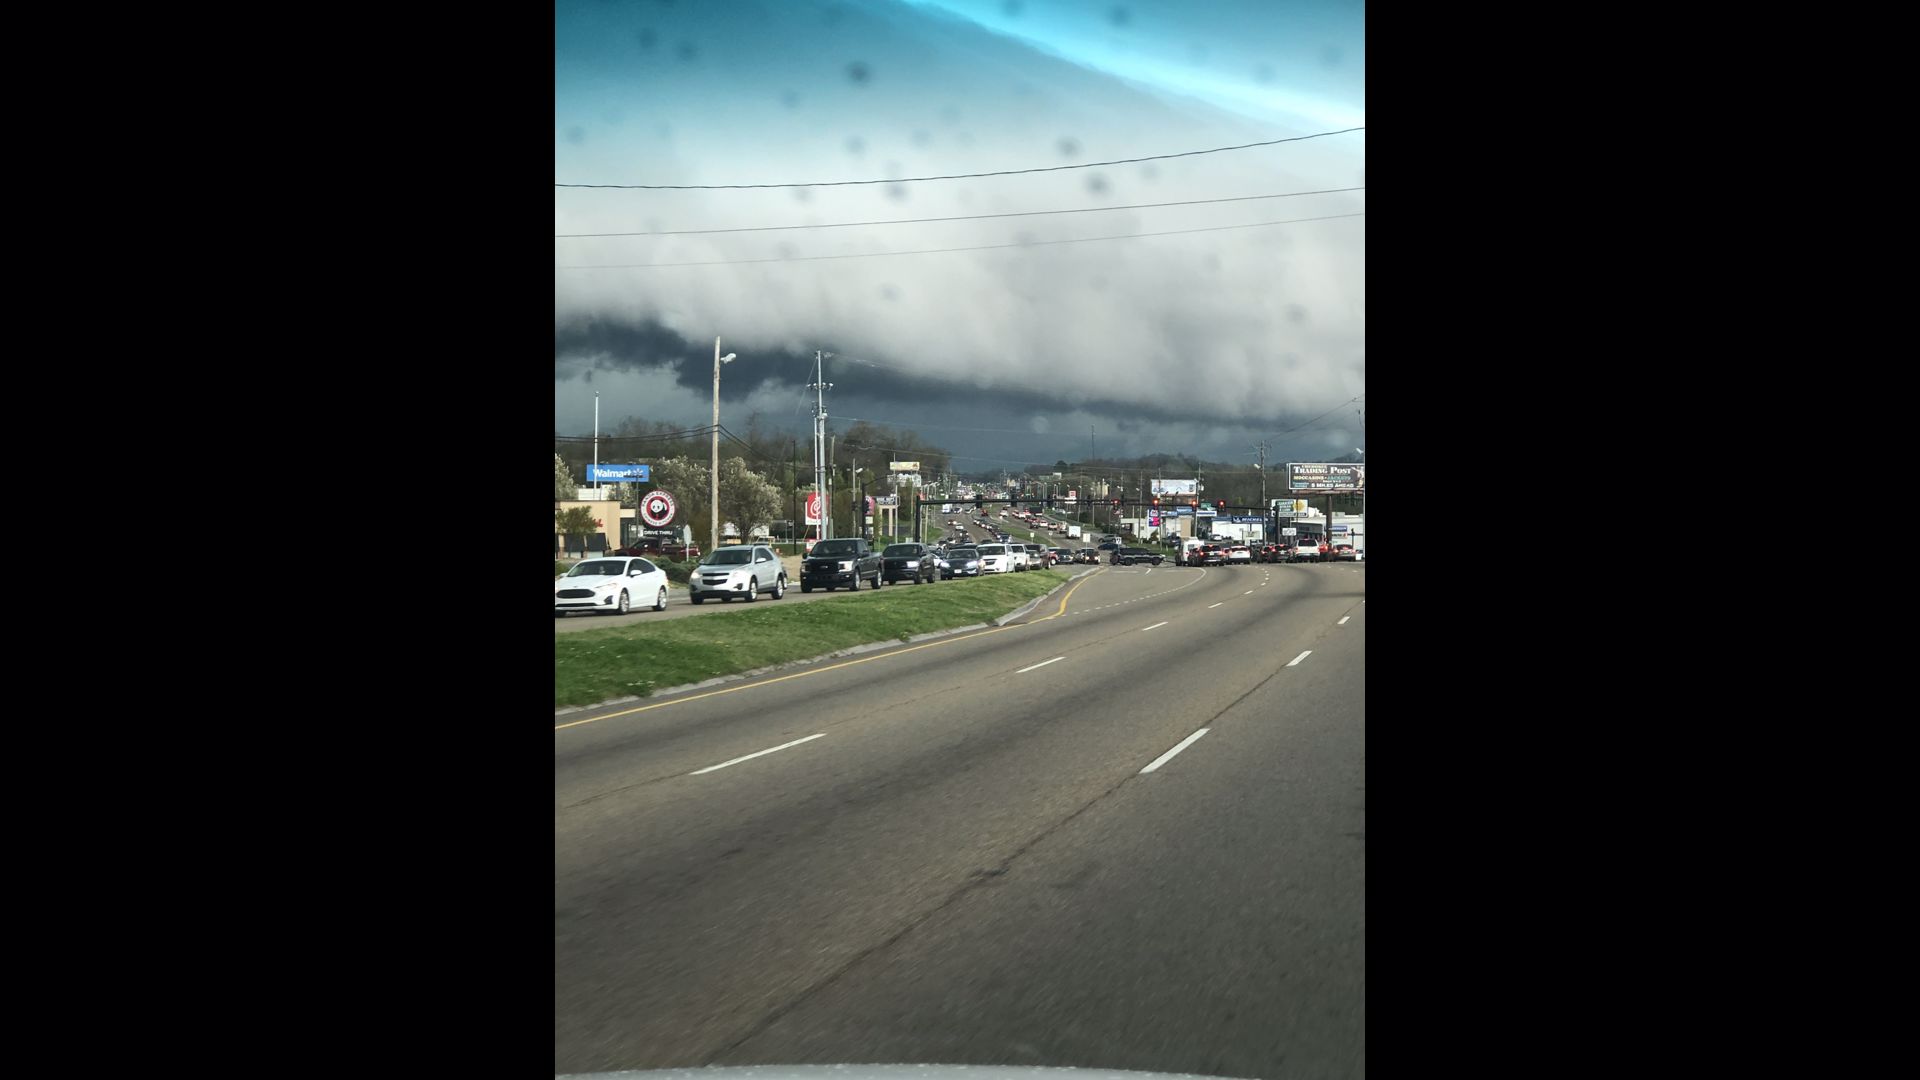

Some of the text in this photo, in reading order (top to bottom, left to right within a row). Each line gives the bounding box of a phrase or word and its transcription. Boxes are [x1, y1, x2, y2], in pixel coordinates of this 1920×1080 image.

[592, 469, 631, 478] Walmart
[1293, 466, 1351, 474] TRADING POST
